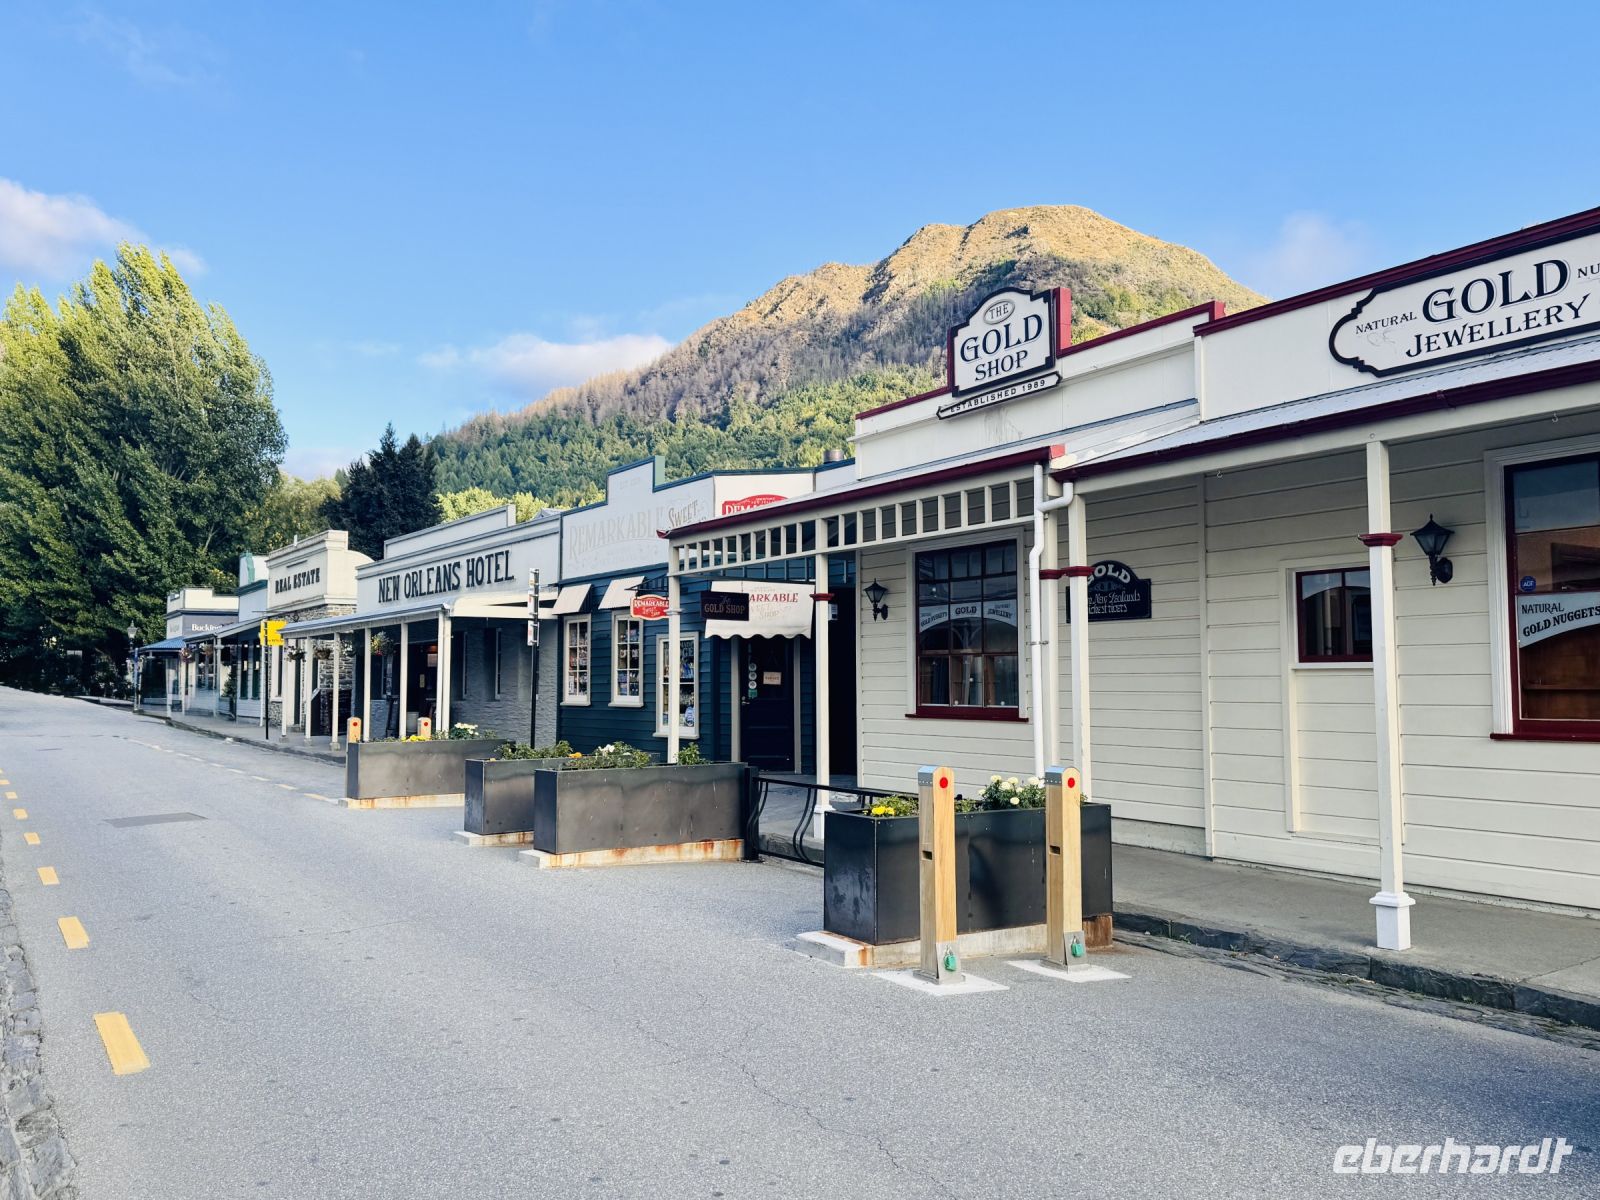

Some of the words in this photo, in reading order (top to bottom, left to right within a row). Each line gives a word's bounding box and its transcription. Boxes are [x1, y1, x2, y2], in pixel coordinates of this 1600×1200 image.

[989, 303, 1009, 319] THE
[1355, 311, 1417, 335] NATURAL
[1422, 259, 1569, 324] GOLD
[960, 314, 1043, 363] GOLD
[1405, 293, 1591, 358] JEWELLERY
[974, 350, 1028, 382] SHOP
[950, 388, 1017, 413] ESTABLISHED
[1022, 379, 1046, 392] 1989
[275, 578, 292, 594] REAL
[293, 567, 320, 589] ESTATE
[378, 574, 401, 603] NEW
[403, 561, 461, 599] ORLEANS
[465, 549, 515, 588] HOTEL
[704, 603, 724, 613] GOLD
[725, 604, 746, 615] SHOP
[955, 606, 977, 615] GOLD
[1521, 602, 1565, 615] NATURAL
[1522, 618, 1551, 637] GOLD
[1552, 605, 1600, 627] NUGGETS
